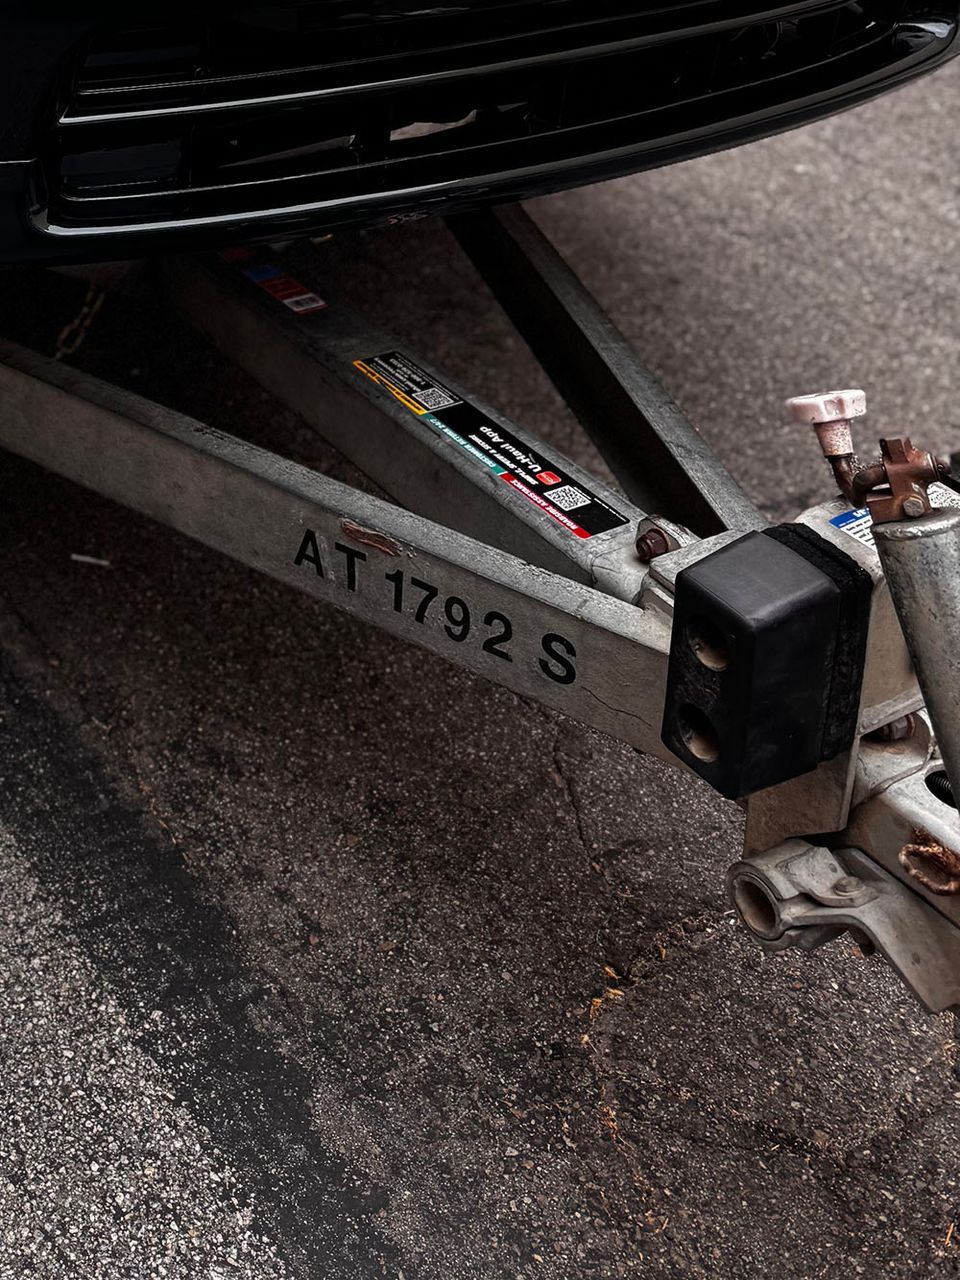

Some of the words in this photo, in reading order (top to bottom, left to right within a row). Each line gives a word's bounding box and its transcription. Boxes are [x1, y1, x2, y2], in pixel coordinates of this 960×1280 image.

[479, 425, 504, 442] App
[464, 443, 495, 467] CUSTOMER
[500, 442, 542, 472] U-Haul
[510, 479, 547, 508] ASSISTANCE
[545, 504, 576, 530] ROADSIDE
[385, 569, 513, 663] 1792
[538, 633, 577, 684] S
